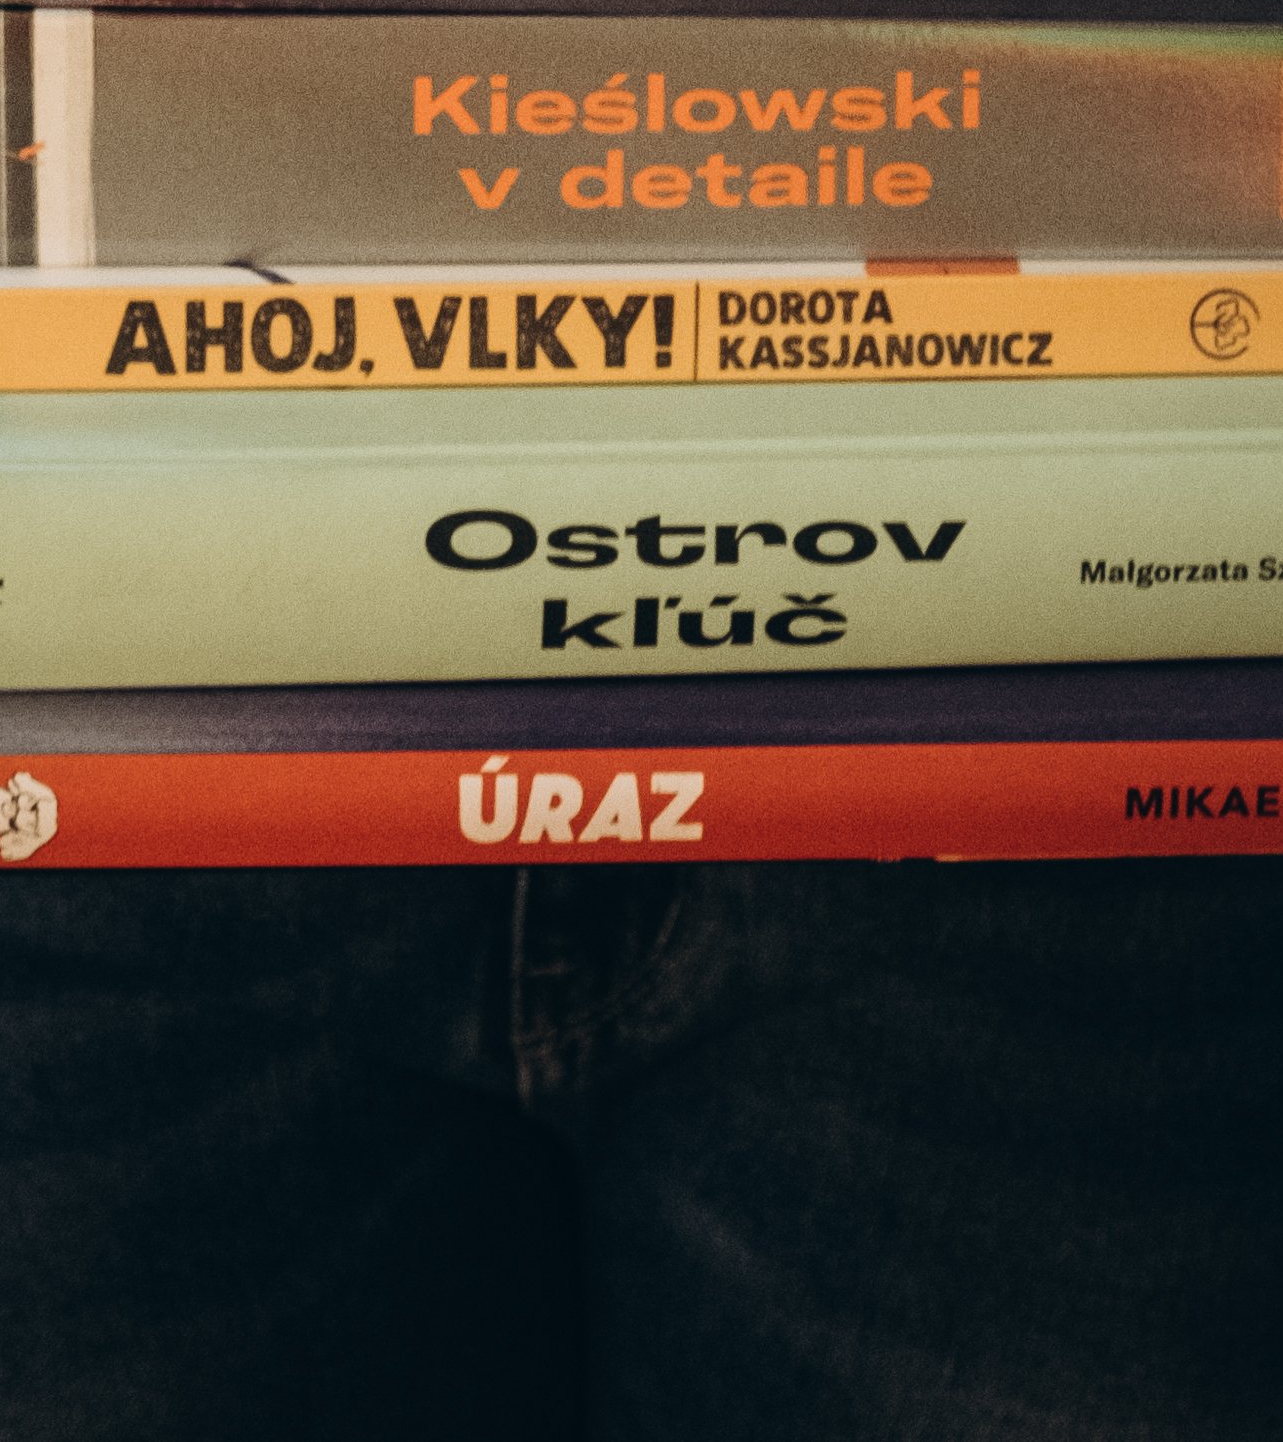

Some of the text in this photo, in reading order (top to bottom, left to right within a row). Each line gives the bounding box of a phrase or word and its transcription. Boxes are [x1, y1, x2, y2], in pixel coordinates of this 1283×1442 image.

[413, 69, 981, 136] Kieślowski
[459, 144, 934, 211] v detaile
[105, 294, 675, 377] AHOJ, VLKY!
[718, 290, 893, 325] DOROTA
[718, 332, 1055, 372] KASSJANOWICZ
[425, 509, 967, 571] Ostrov
[541, 592, 849, 650] kľúč
[457, 754, 705, 843] ÚRAZ
